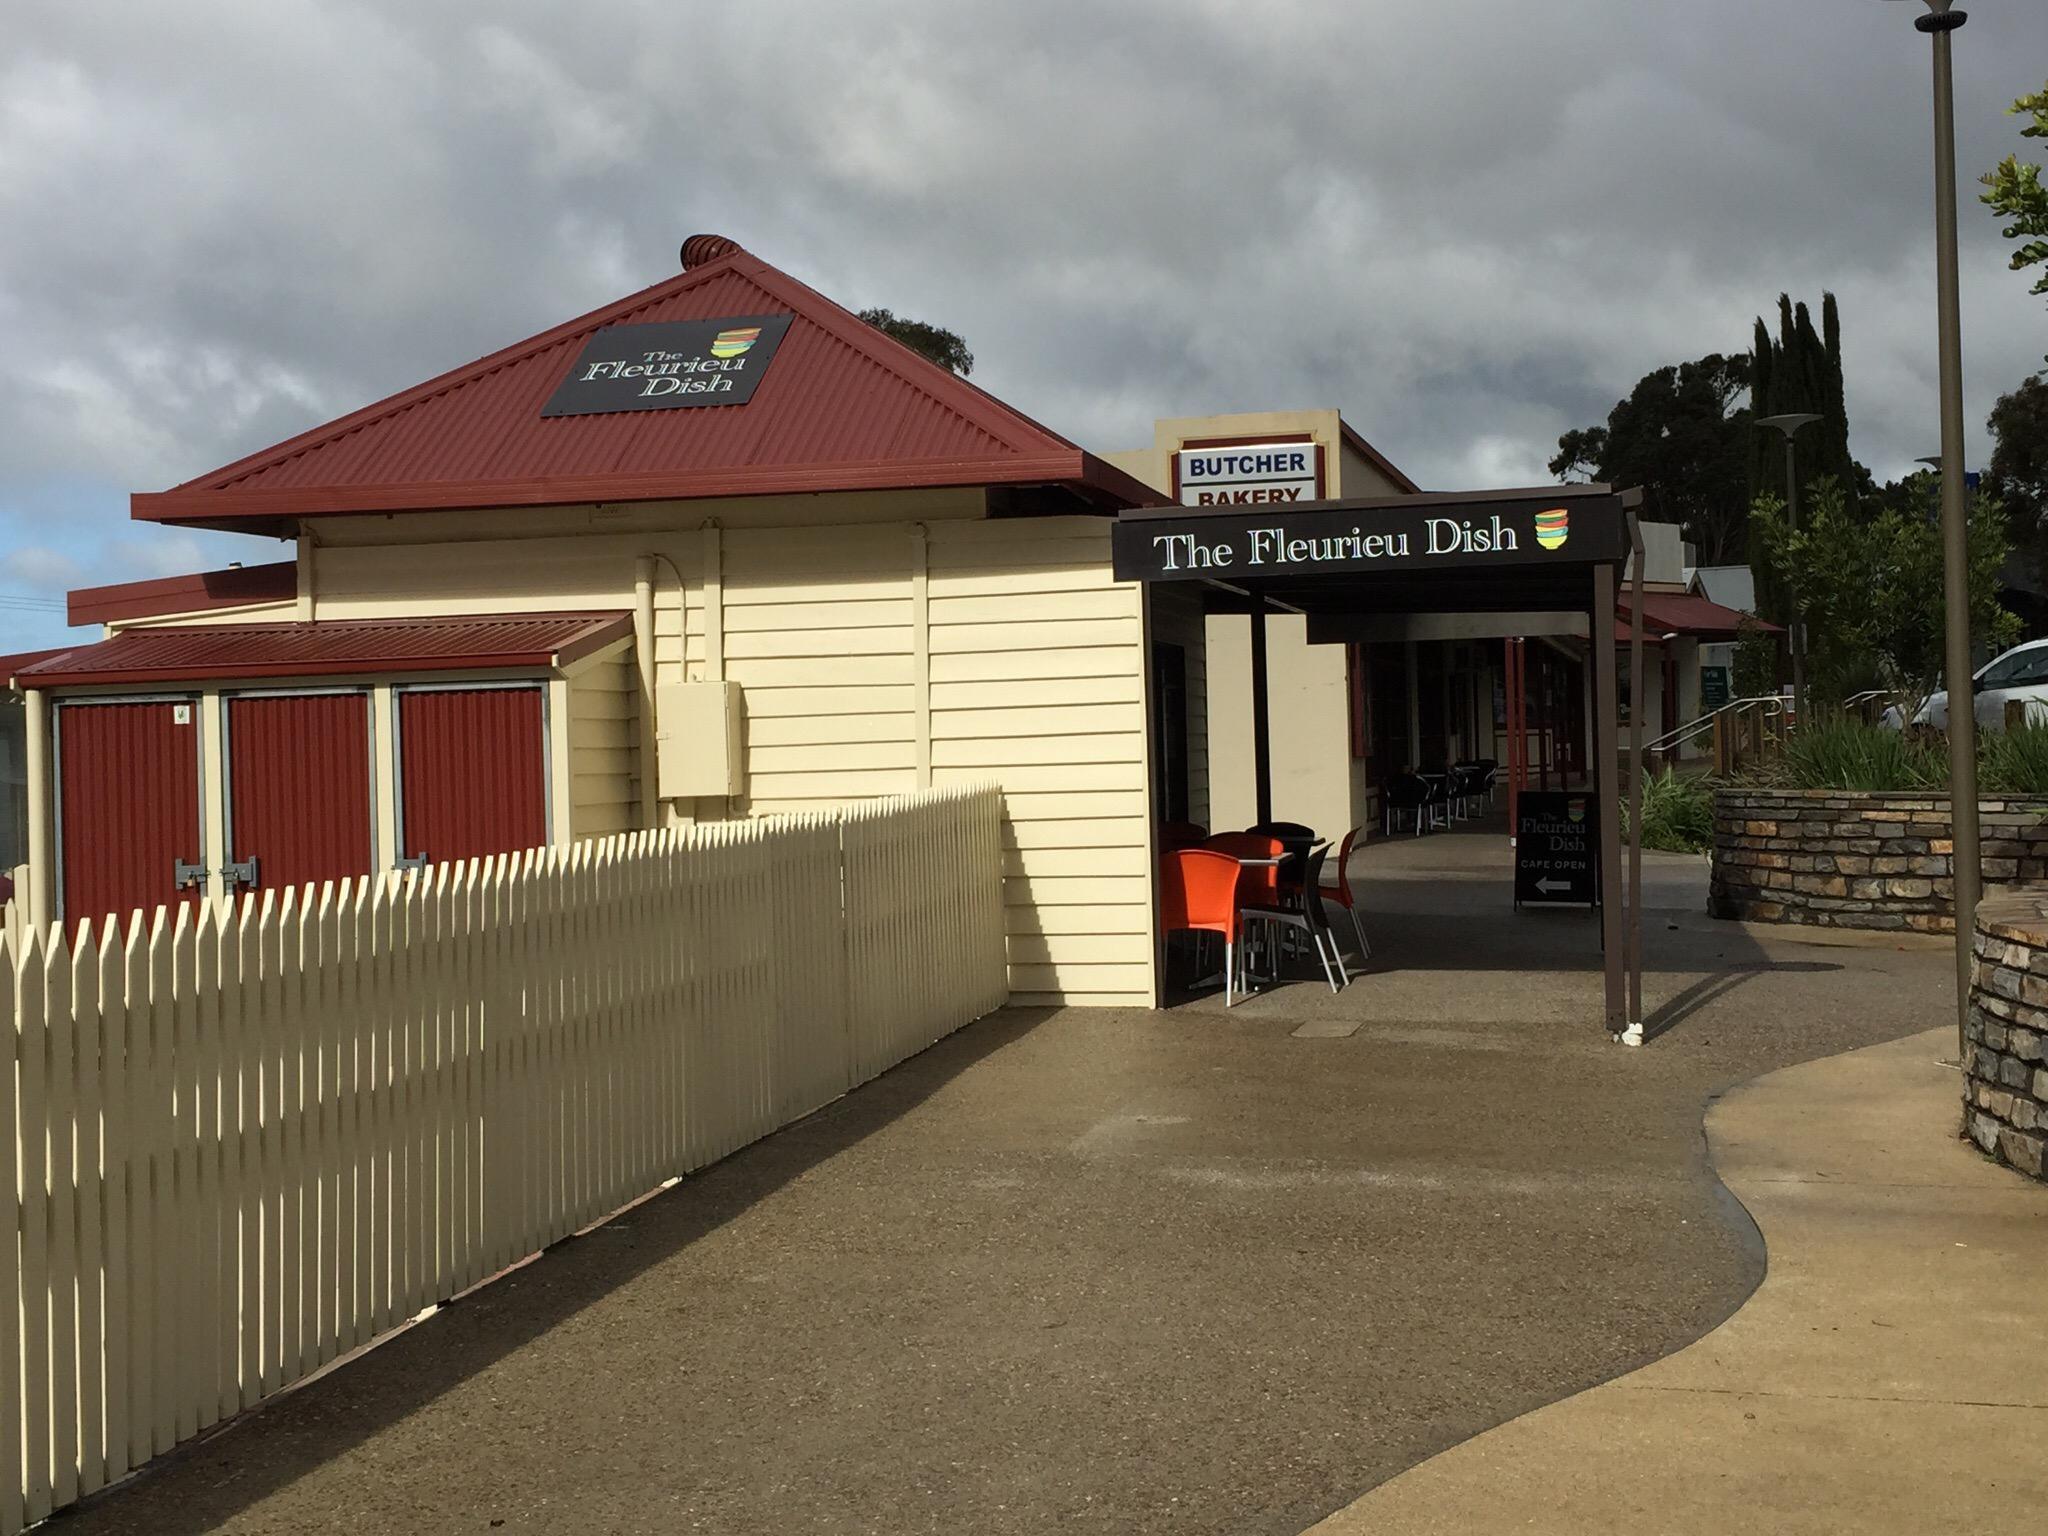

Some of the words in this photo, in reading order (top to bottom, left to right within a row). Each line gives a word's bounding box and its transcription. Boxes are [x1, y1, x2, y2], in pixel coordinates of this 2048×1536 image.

[643, 351, 683, 363] The
[579, 358, 746, 381] Fleurieu
[637, 374, 733, 397] Dish
[1190, 453, 1306, 477] BUTCHER
[1198, 487, 1302, 505] BAKERY
[1153, 534, 1233, 570] The
[1247, 527, 1410, 566] Fleurieu
[1424, 516, 1519, 555] Dish
[1520, 817, 1587, 834] Fleurieu
[1549, 835, 1586, 852] Dish
[1520, 860, 1550, 869] CAFE
[1554, 860, 1587, 870] OPEN
